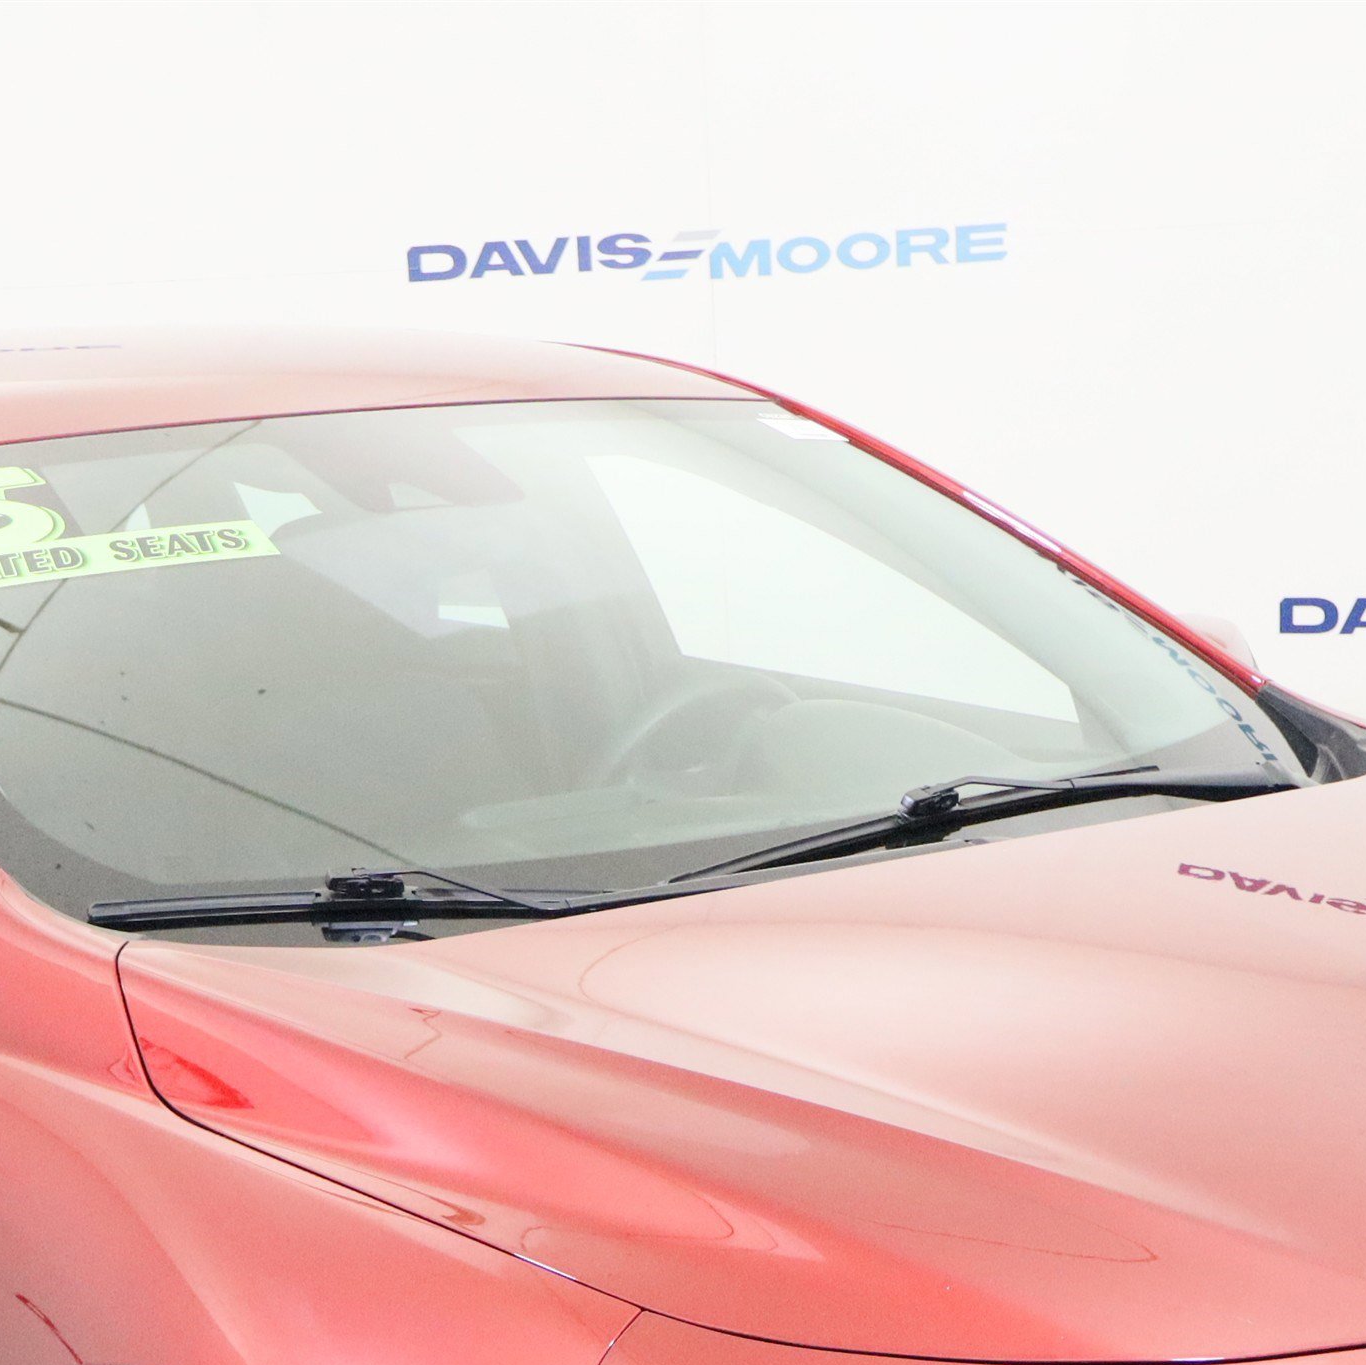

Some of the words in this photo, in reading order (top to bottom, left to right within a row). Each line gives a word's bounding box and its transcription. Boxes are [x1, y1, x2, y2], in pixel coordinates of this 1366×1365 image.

[406, 232, 653, 283] DAVIS
[709, 222, 1008, 280] MOORE
[108, 527, 252, 563] SEATS
